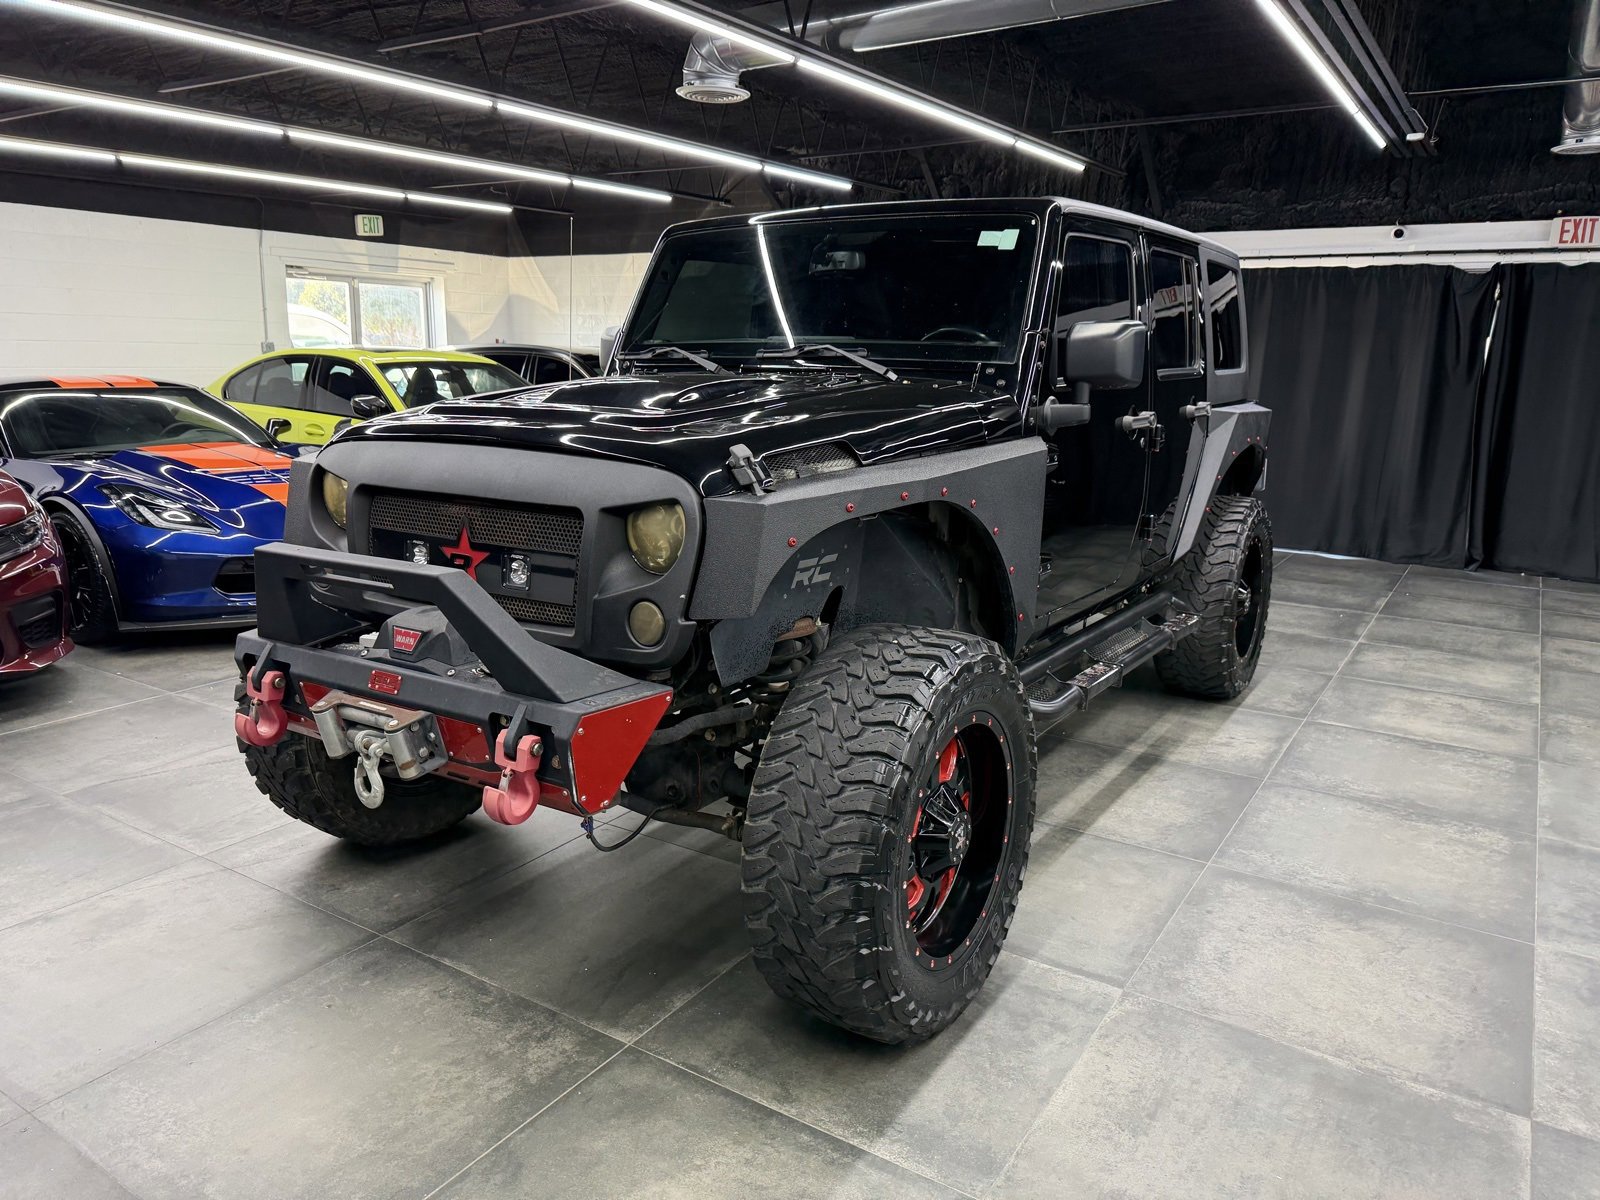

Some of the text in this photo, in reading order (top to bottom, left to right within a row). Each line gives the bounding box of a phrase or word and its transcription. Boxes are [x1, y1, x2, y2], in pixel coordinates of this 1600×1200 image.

[362, 216, 380, 234] EXIT
[1558, 218, 1600, 244] EXIT
[790, 553, 839, 590] RC
[395, 634, 415, 646] WARN
